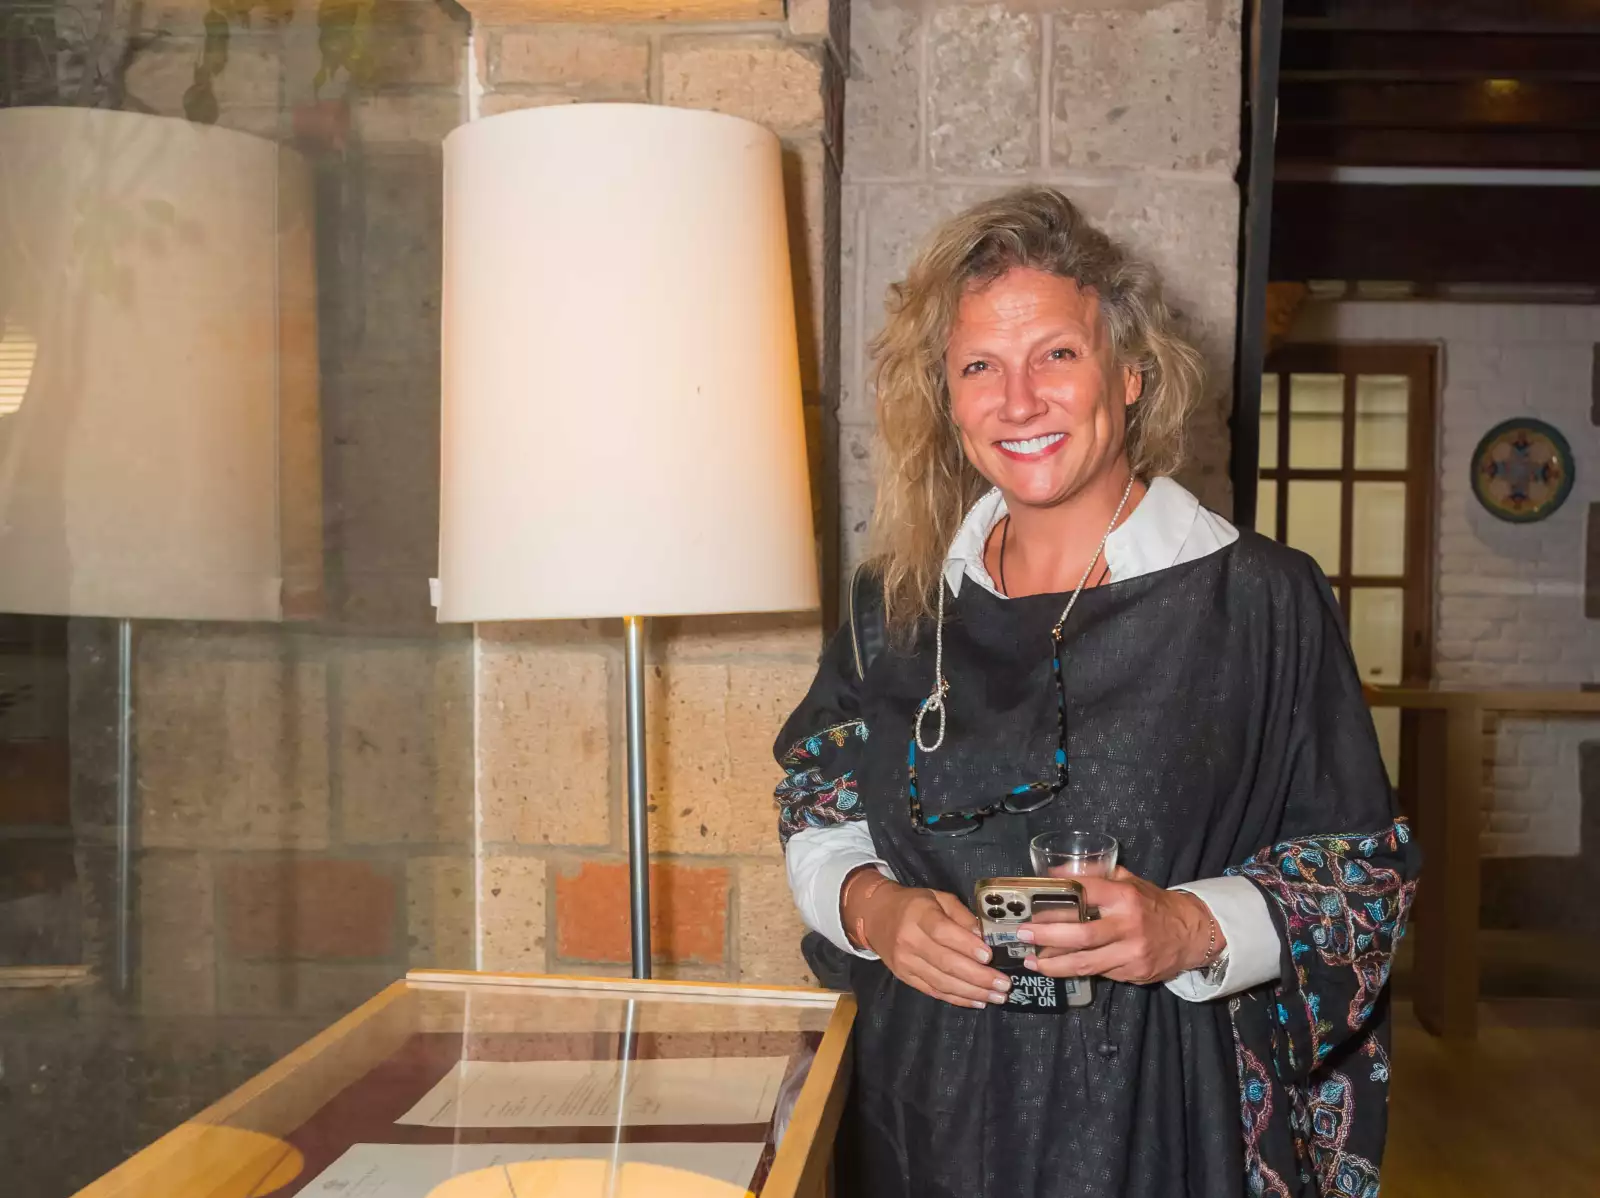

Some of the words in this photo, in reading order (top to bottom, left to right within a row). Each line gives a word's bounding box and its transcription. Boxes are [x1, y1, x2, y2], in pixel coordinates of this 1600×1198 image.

[1011, 975, 1055, 987] CANES
[1025, 987, 1055, 997] LIVE
[1038, 997, 1056, 1007] ON
